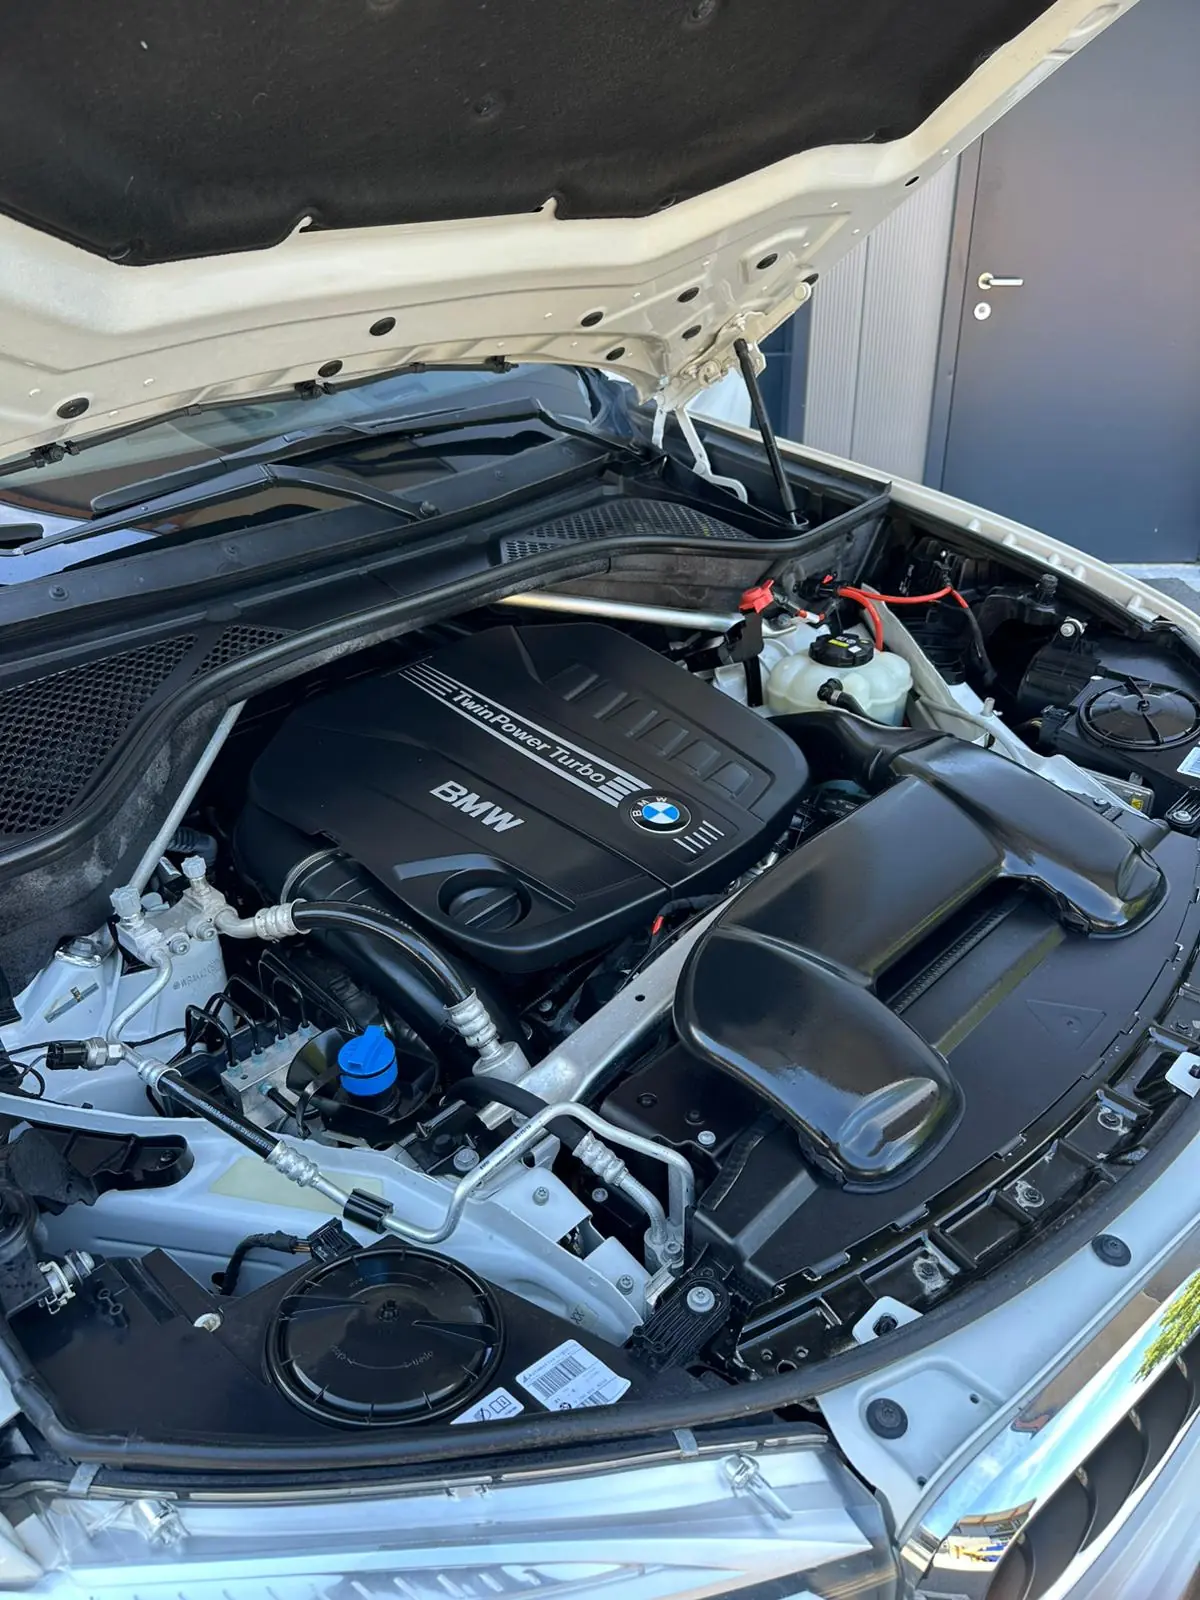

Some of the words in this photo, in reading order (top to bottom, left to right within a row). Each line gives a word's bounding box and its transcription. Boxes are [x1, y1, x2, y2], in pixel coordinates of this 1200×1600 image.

[452, 690, 550, 752] TwinPower
[548, 746, 606, 783] Turbo
[429, 780, 525, 833] BMW
